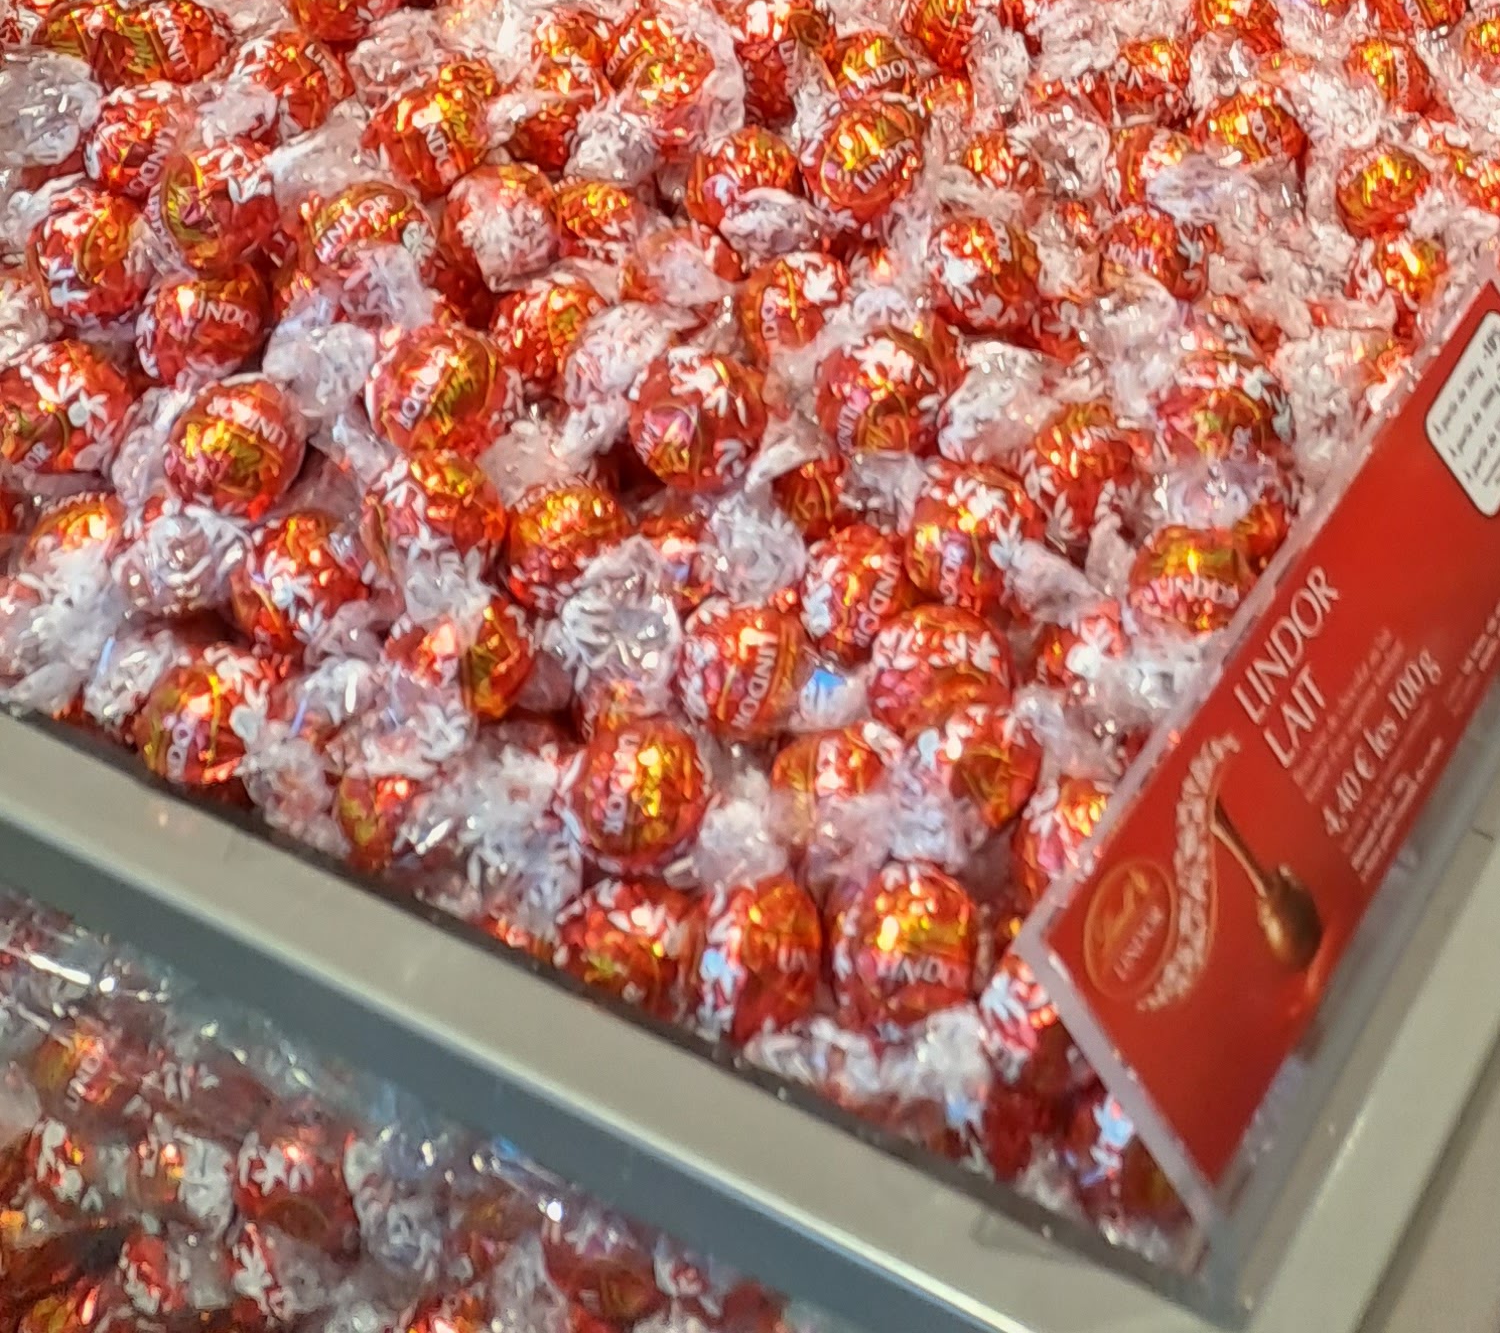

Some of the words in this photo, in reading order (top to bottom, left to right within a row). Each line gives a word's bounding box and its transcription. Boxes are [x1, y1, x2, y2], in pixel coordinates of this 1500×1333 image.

[315, 192, 393, 264] LINDOR
[198, 297, 260, 331] INDO
[1233, 565, 1340, 726] LINDOR
[1262, 666, 1328, 770] LAIT
[1317, 770, 1363, 841] 4,40
[1350, 742, 1376, 782] €
[1367, 708, 1399, 758] les
[1388, 643, 1441, 724] 100g
[875, 954, 961, 988] LINDO
